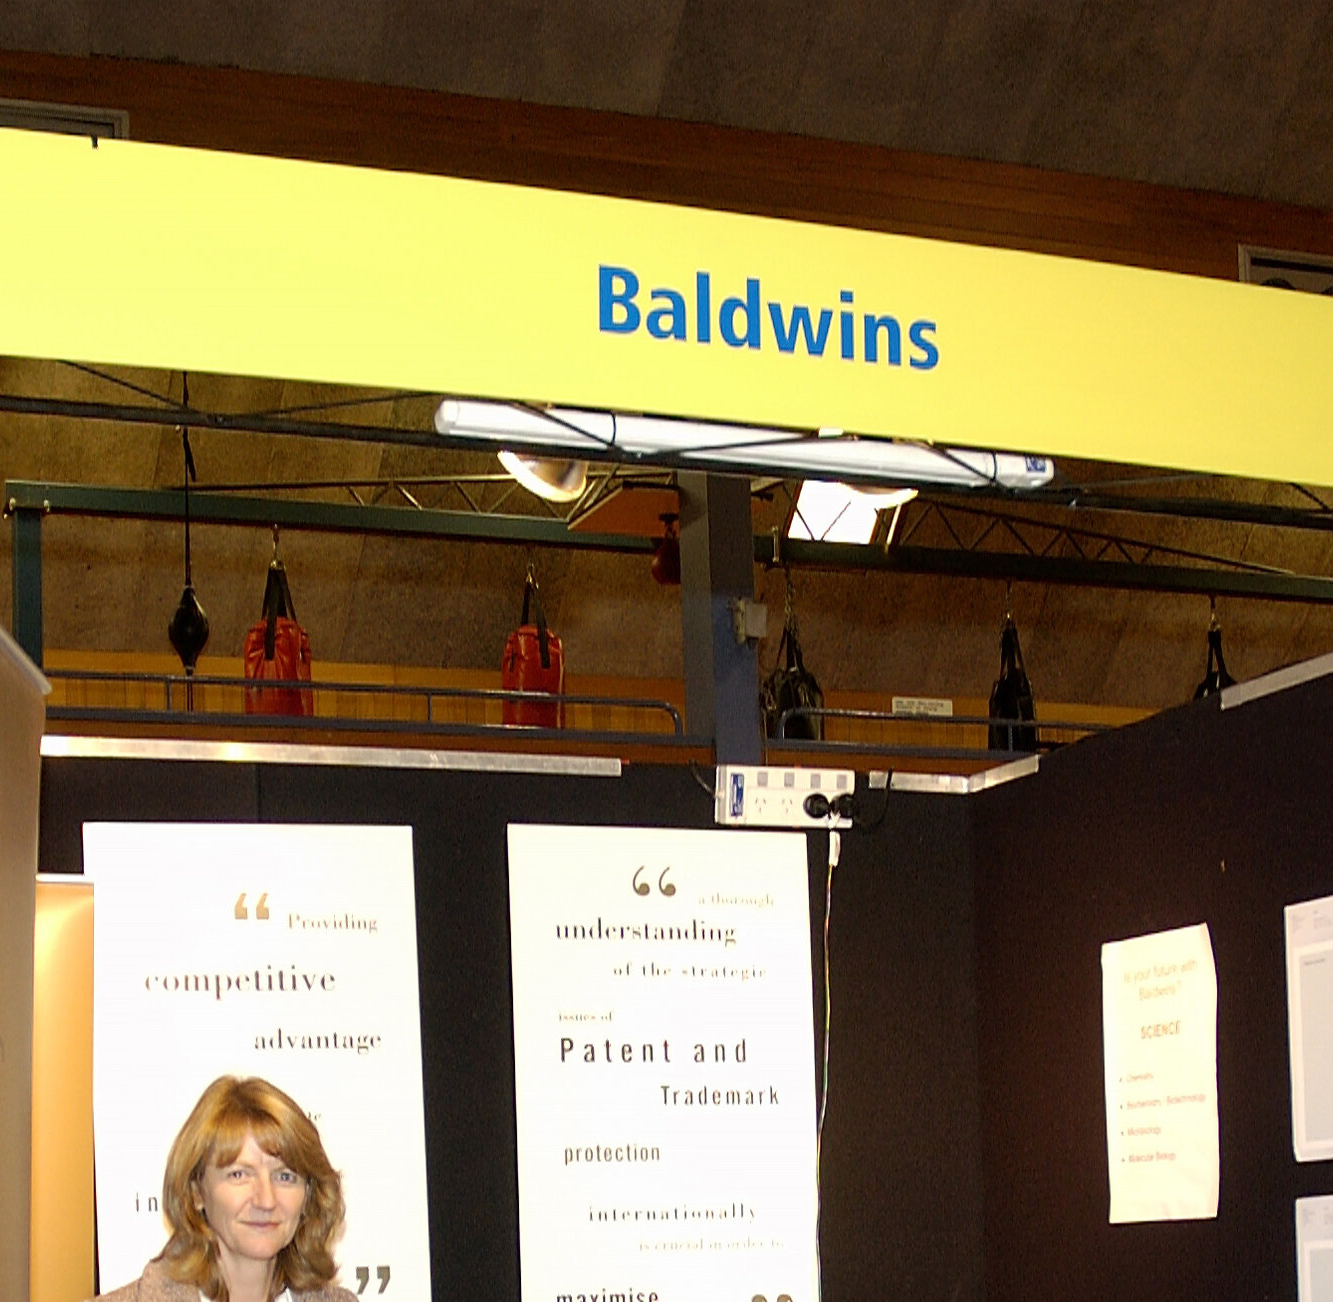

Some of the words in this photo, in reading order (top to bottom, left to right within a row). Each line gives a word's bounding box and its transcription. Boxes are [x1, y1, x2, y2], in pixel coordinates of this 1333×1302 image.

[598, 264, 940, 371] Baldwins
[287, 911, 379, 934] Providing
[555, 916, 737, 948] understanding
[144, 964, 337, 1001] competitive
[613, 961, 633, 977] of
[641, 961, 671, 977] the
[681, 964, 767, 981] strategic
[253, 1027, 383, 1055] advantage
[1140, 1020, 1182, 1040] SCIENCE
[559, 1037, 671, 1064] Patent
[693, 1038, 747, 1064] and
[660, 1085, 780, 1106] Trademark
[563, 1143, 661, 1167] protection
[588, 1202, 756, 1224] internationally
